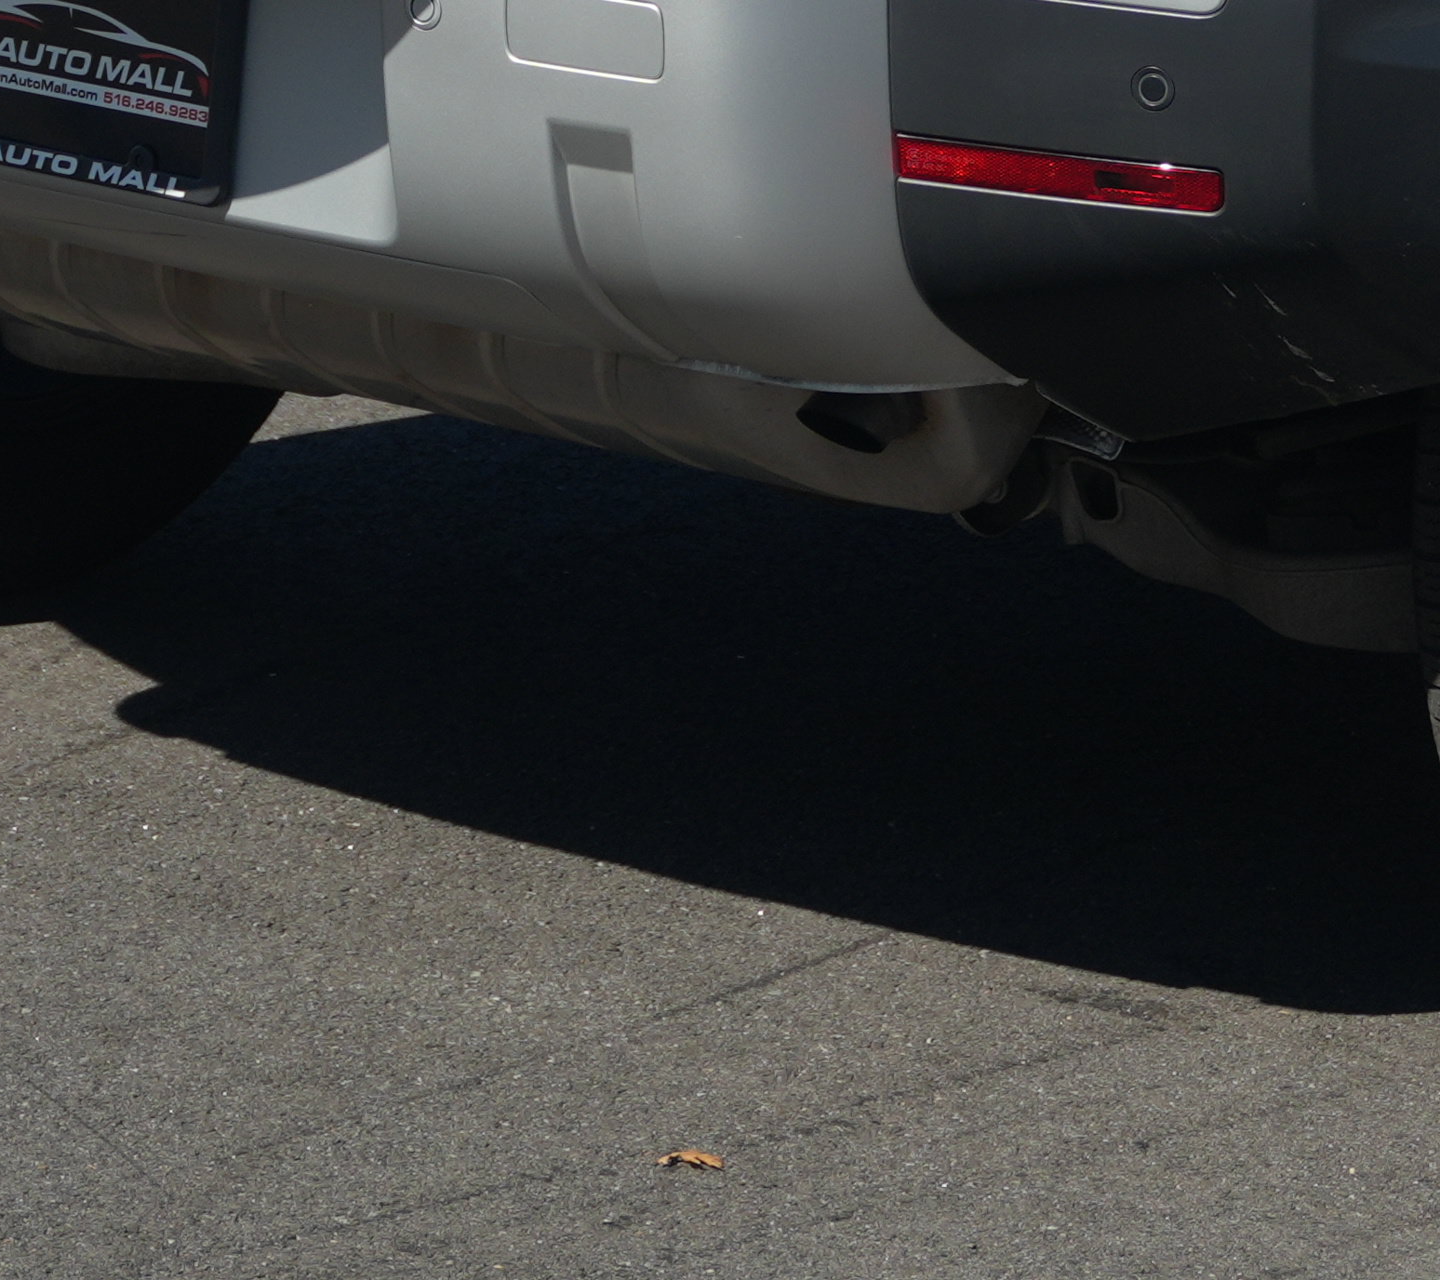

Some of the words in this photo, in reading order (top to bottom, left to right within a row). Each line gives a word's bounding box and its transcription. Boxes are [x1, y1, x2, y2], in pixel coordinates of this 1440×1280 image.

[96, 57, 194, 98] MALL
[103, 90, 209, 124] 516.246.9283
[87, 161, 186, 198] MALL
